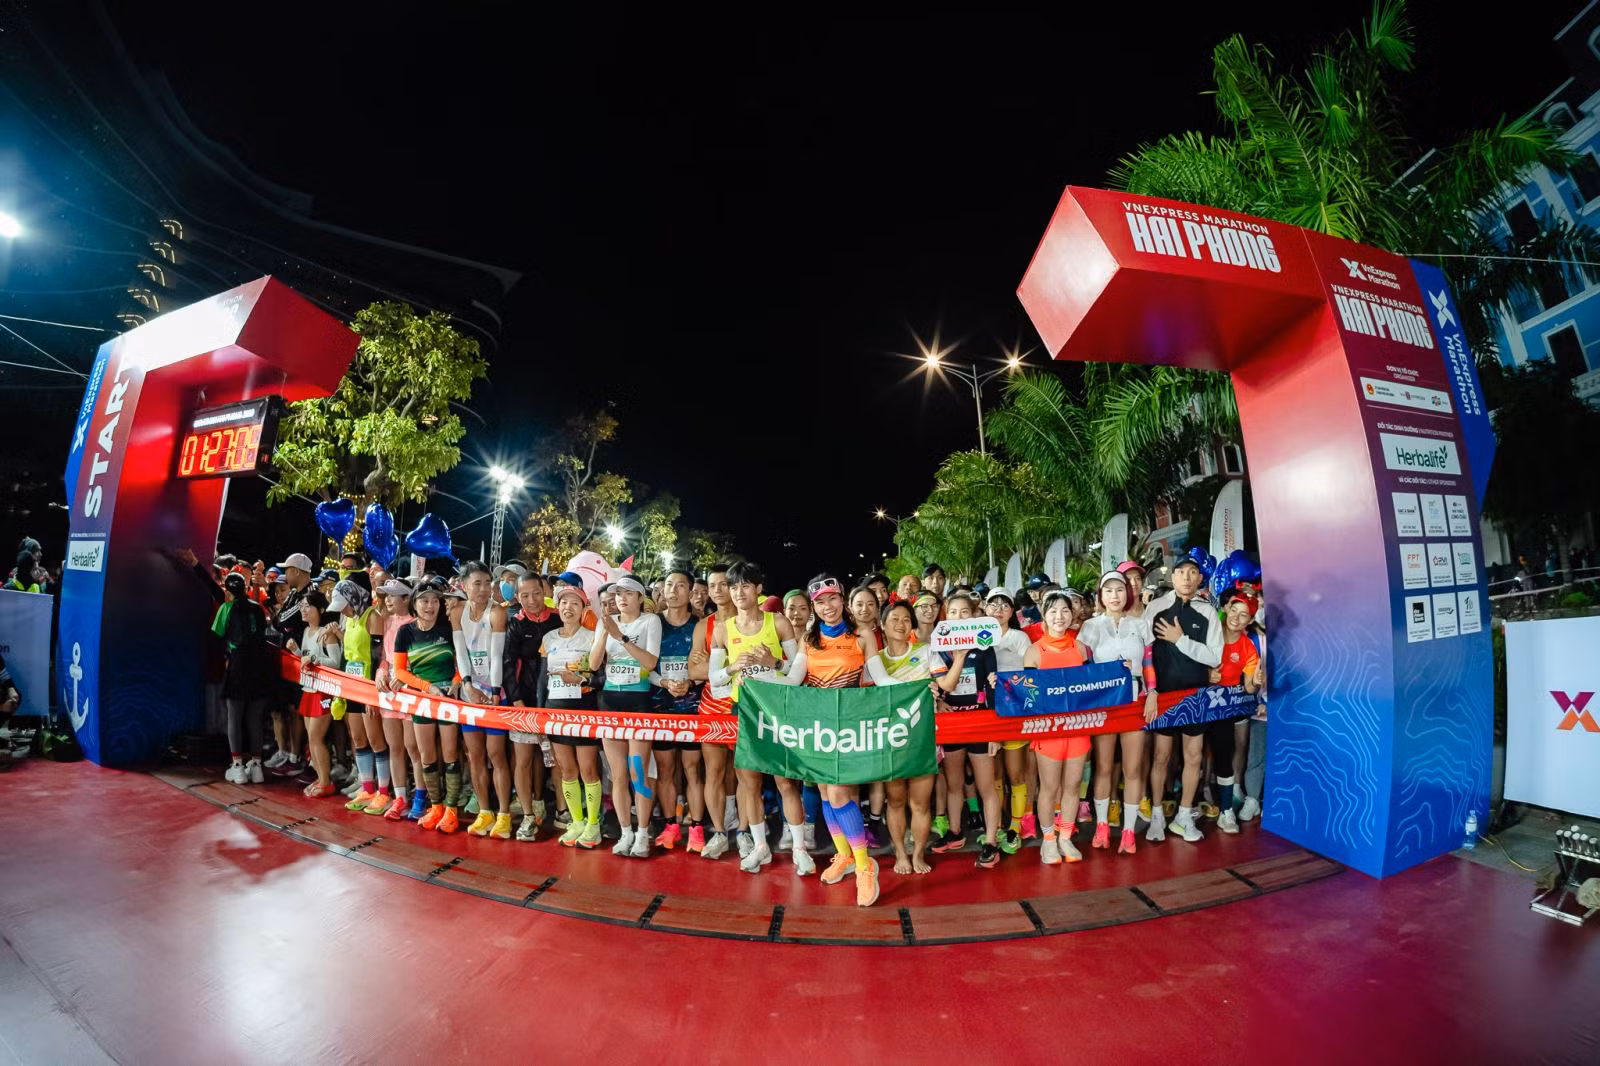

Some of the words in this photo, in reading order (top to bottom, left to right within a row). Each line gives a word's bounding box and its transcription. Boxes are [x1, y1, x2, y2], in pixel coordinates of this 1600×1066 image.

[1122, 201, 1200, 221] VNEXPRESS
[1203, 214, 1270, 234] MARATHON
[1125, 212, 1188, 258] HAI
[1182, 220, 1282, 273] PHONG
[1361, 263, 1398, 280] VnExpress
[1367, 274, 1401, 290] Marathon
[1330, 283, 1381, 303] VNEXPRESS
[1381, 296, 1424, 315] MARATHON
[1334, 293, 1377, 337] HAI
[1369, 302, 1434, 350] PHONG
[1444, 336, 1472, 414] Marathon
[1452, 332, 1481, 416] VnExpress
[1395, 446, 1446, 469] Herbalife
[71, 551, 96, 568] Herbalife
[937, 637, 952, 646] TAI
[954, 636, 975, 646] SINH
[610, 665, 635, 674] 80211
[1047, 686, 1067, 696] P2P
[1068, 677, 1127, 693] COMMUNITY
[548, 712, 620, 727] VNEXPRESS
[623, 716, 699, 731] MARATHON
[757, 710, 909, 754] Herbalife
